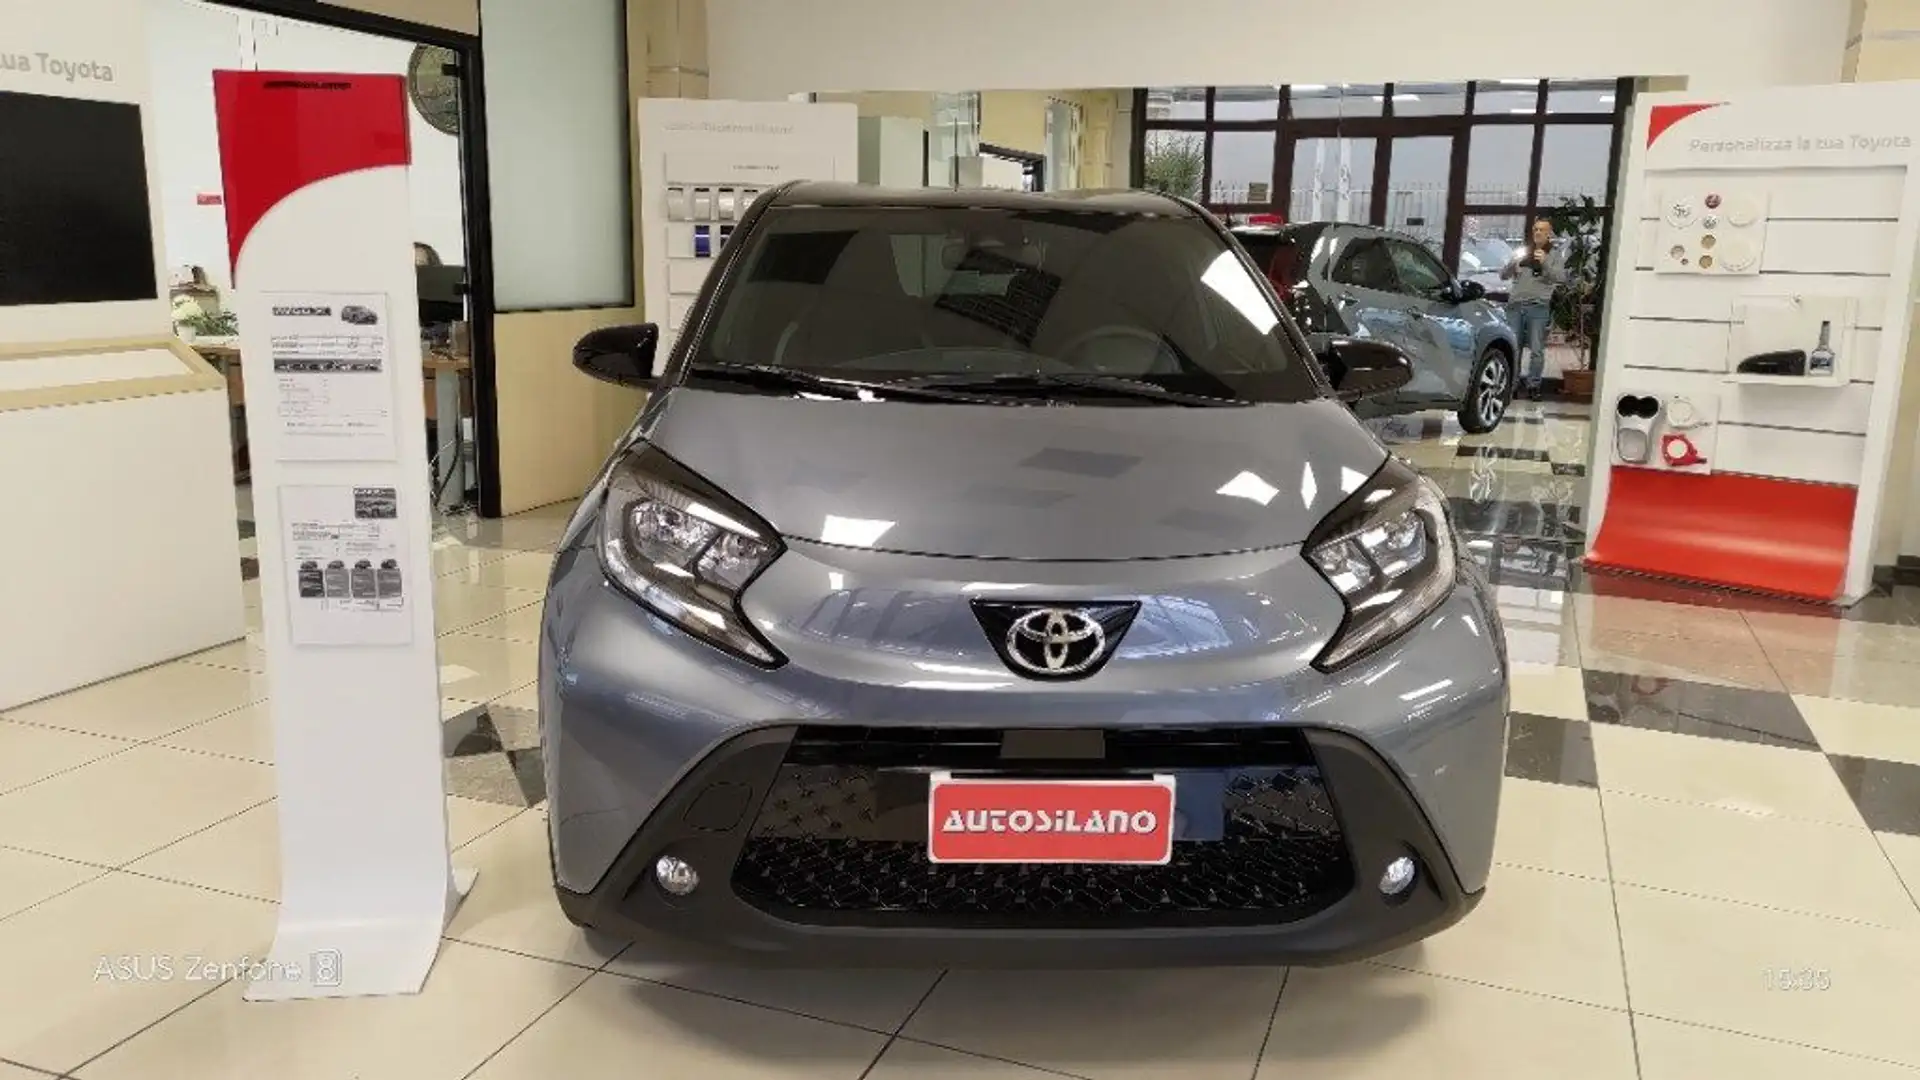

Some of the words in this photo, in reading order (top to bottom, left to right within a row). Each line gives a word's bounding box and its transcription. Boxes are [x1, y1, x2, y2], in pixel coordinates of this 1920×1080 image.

[0, 53, 31, 72] ua
[34, 52, 114, 83] Toyota
[1688, 136, 1793, 154] Personalizza
[1797, 136, 1811, 151] la
[1815, 136, 1844, 151] tua
[1849, 134, 1912, 153] Toyota
